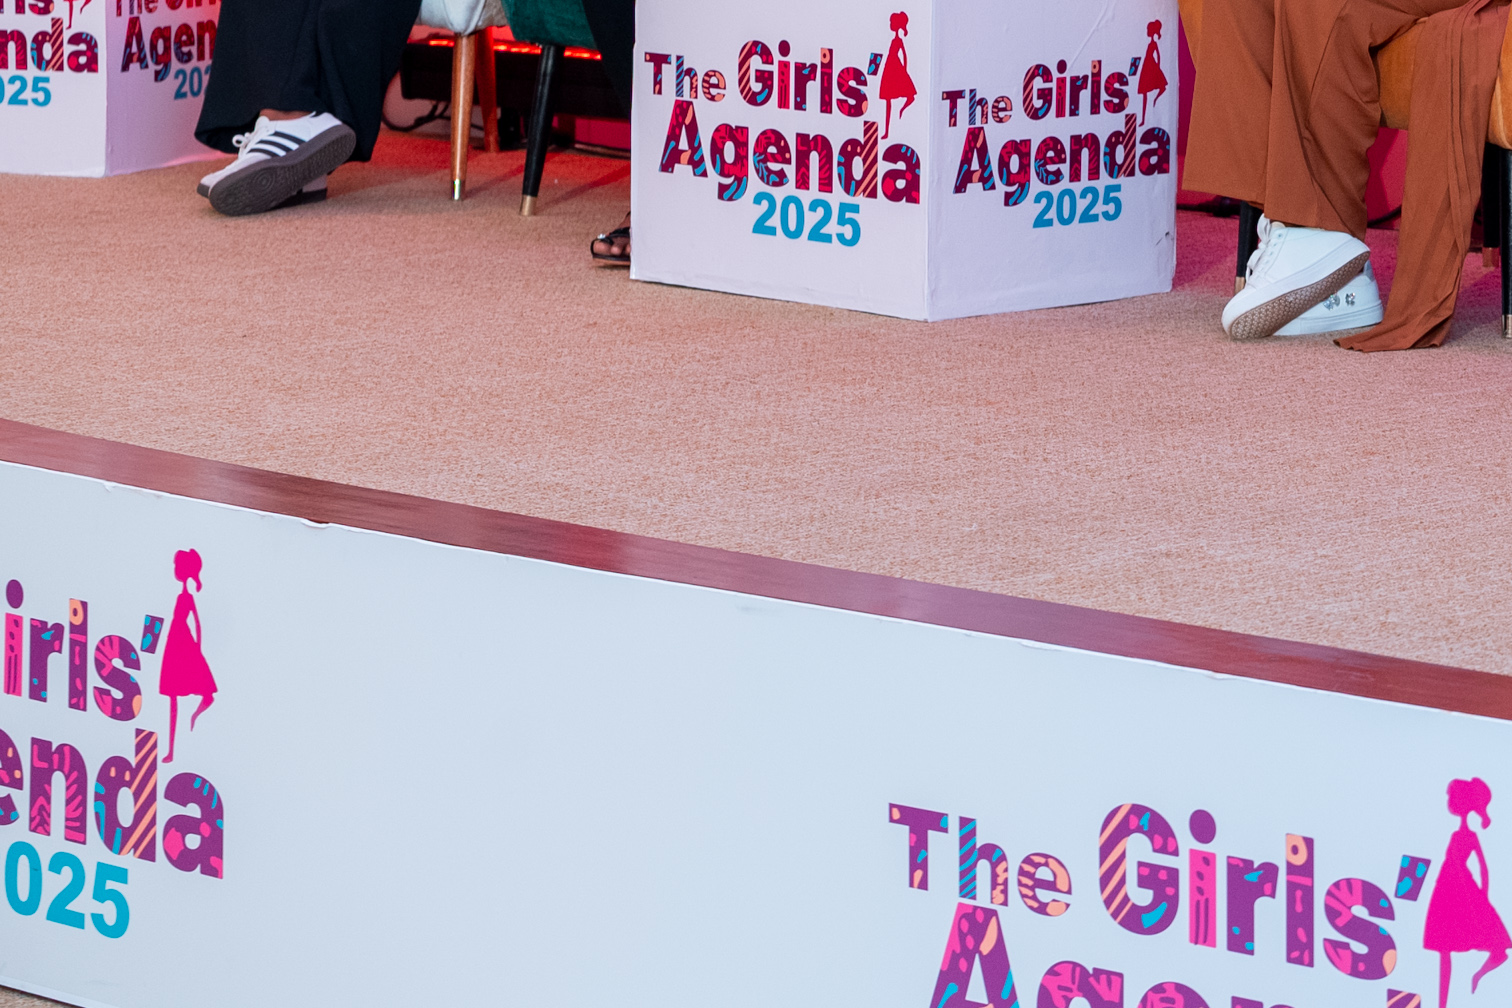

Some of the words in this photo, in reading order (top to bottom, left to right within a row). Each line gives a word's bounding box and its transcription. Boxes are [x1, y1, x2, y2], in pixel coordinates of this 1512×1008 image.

[0, 17, 98, 73] nda
[121, 16, 218, 83] Agen
[644, 52, 727, 102] The
[738, 40, 883, 118] Girls'
[0, 75, 51, 107] 25
[942, 90, 1013, 128] The
[1022, 56, 1141, 121] Girls'
[658, 100, 921, 204] Agenda
[953, 113, 1171, 207] Agenda
[752, 192, 861, 247] 2025
[1032, 184, 1122, 229] 2025
[4, 579, 165, 722] irls'
[4, 841, 130, 939] 025
[888, 802, 1073, 917] The
[1098, 803, 1432, 981] Girls'
